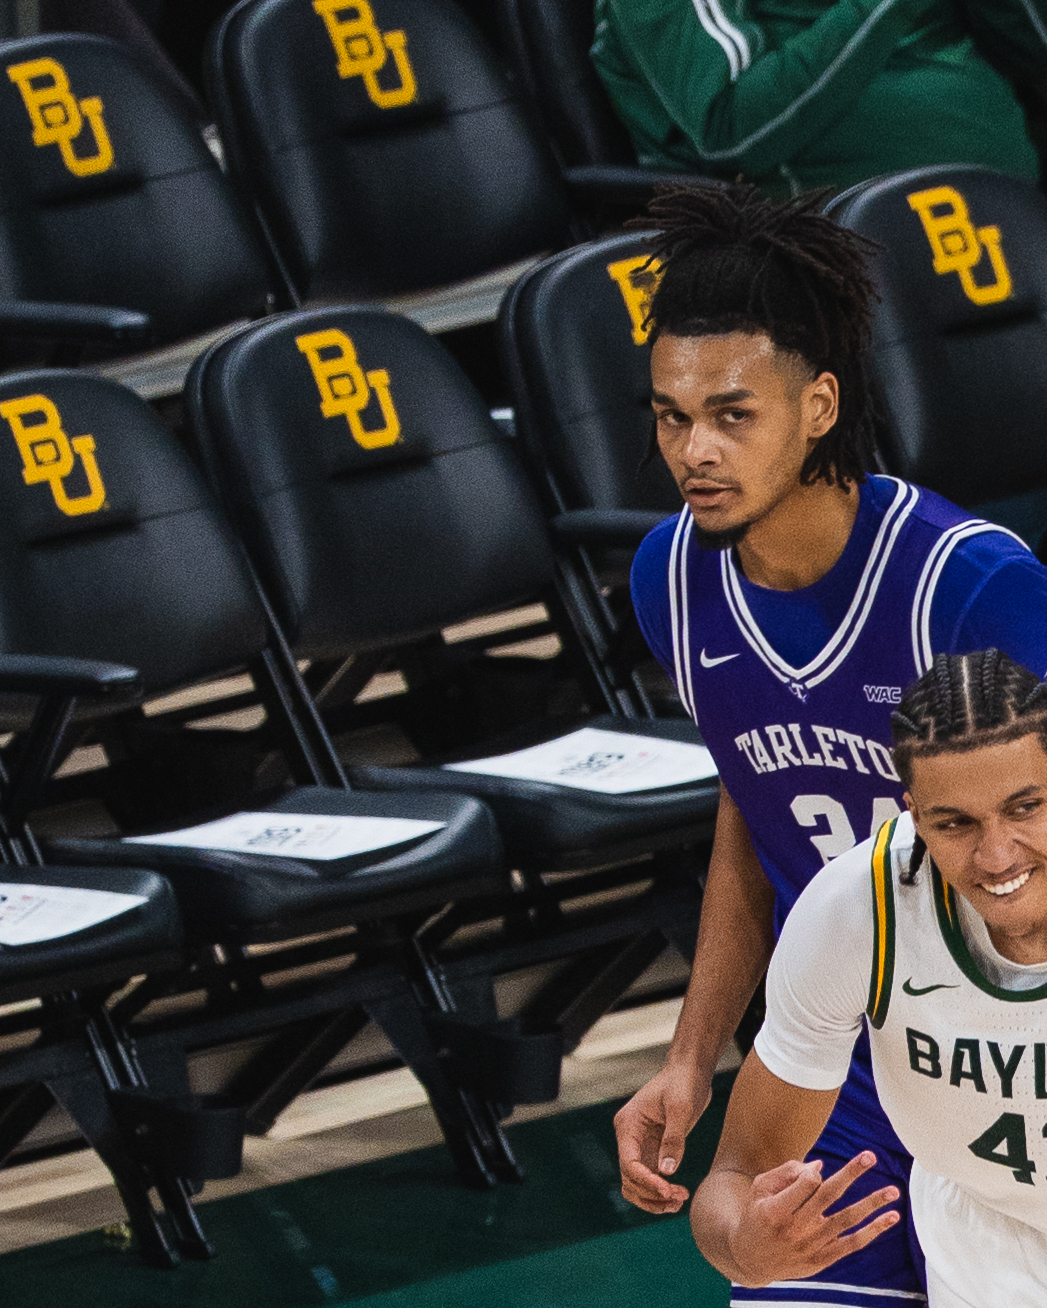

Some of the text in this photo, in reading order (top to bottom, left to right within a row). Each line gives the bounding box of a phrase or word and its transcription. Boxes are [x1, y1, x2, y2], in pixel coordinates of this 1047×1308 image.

[313, 0, 417, 109] BU
[7, 57, 115, 177] BU
[907, 185, 1013, 306] BU
[295, 328, 402, 450] BU
[0, 394, 106, 517] BU
[863, 685, 901, 704] WAC
[734, 723, 901, 782] TARLETO
[789, 794, 902, 866] 2
